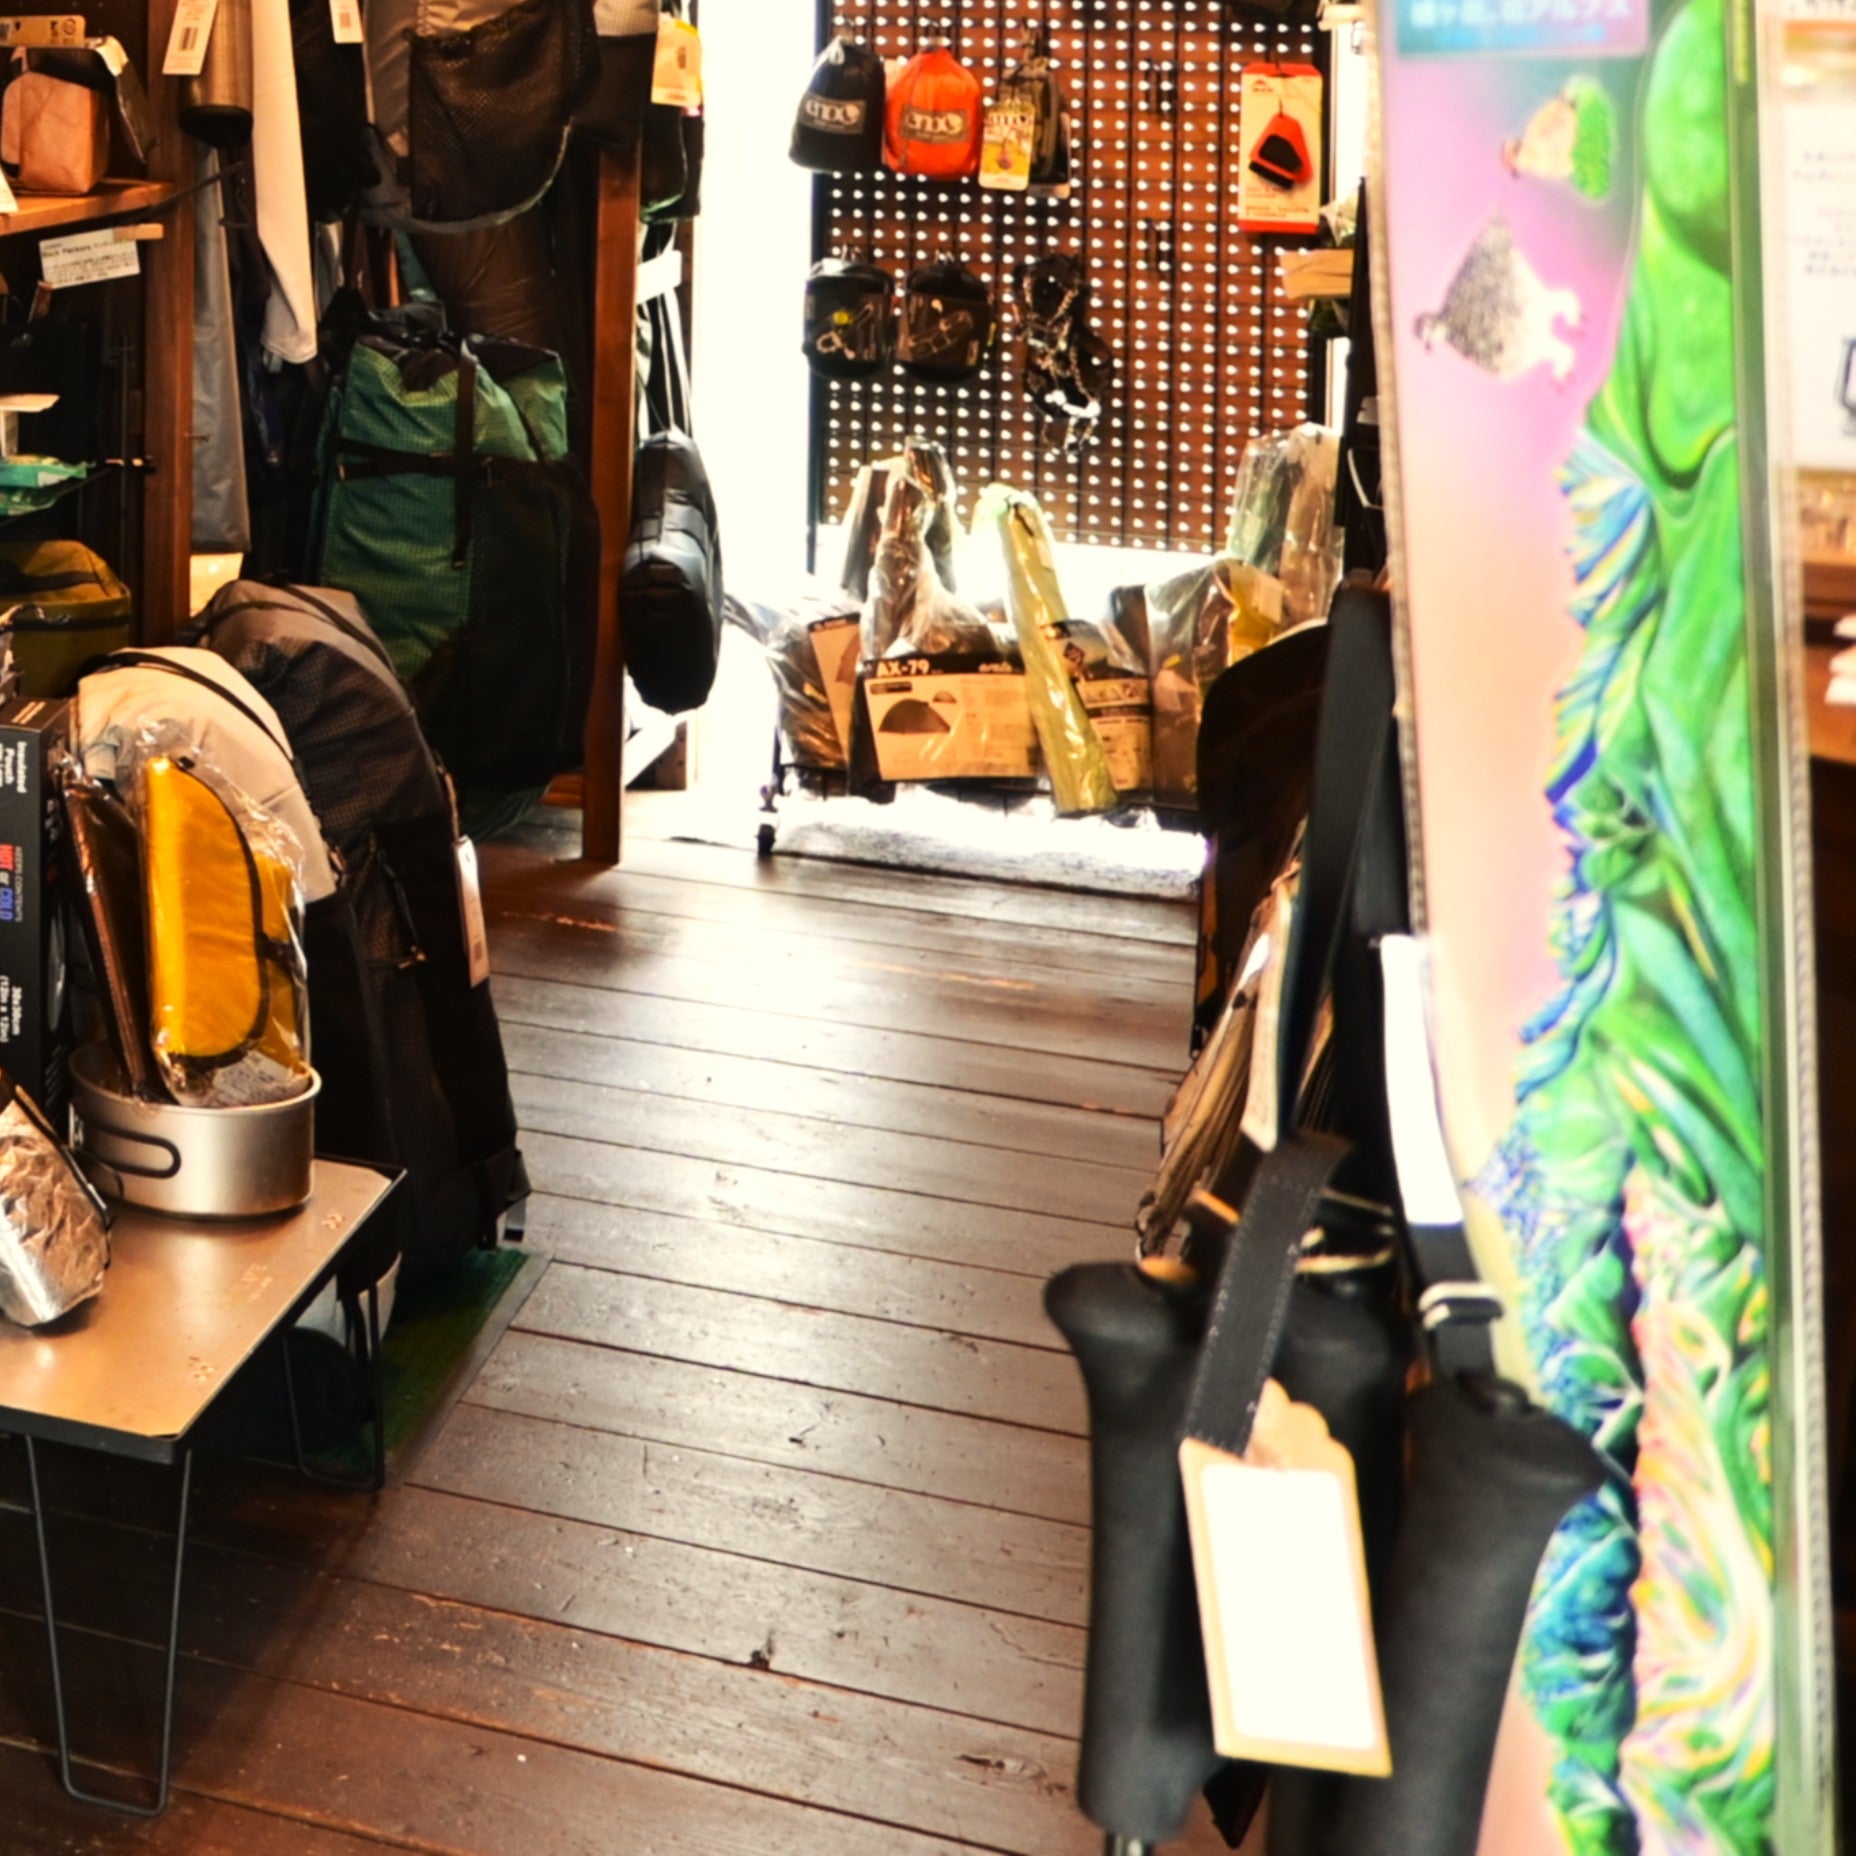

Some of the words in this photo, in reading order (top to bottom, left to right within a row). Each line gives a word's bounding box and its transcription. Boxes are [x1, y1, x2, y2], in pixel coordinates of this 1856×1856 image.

[876, 660, 930, 679] AX-79
[3, 747, 15, 785] Pouch
[15, 741, 27, 794] Insulated
[14, 874, 23, 923] CONTENTS
